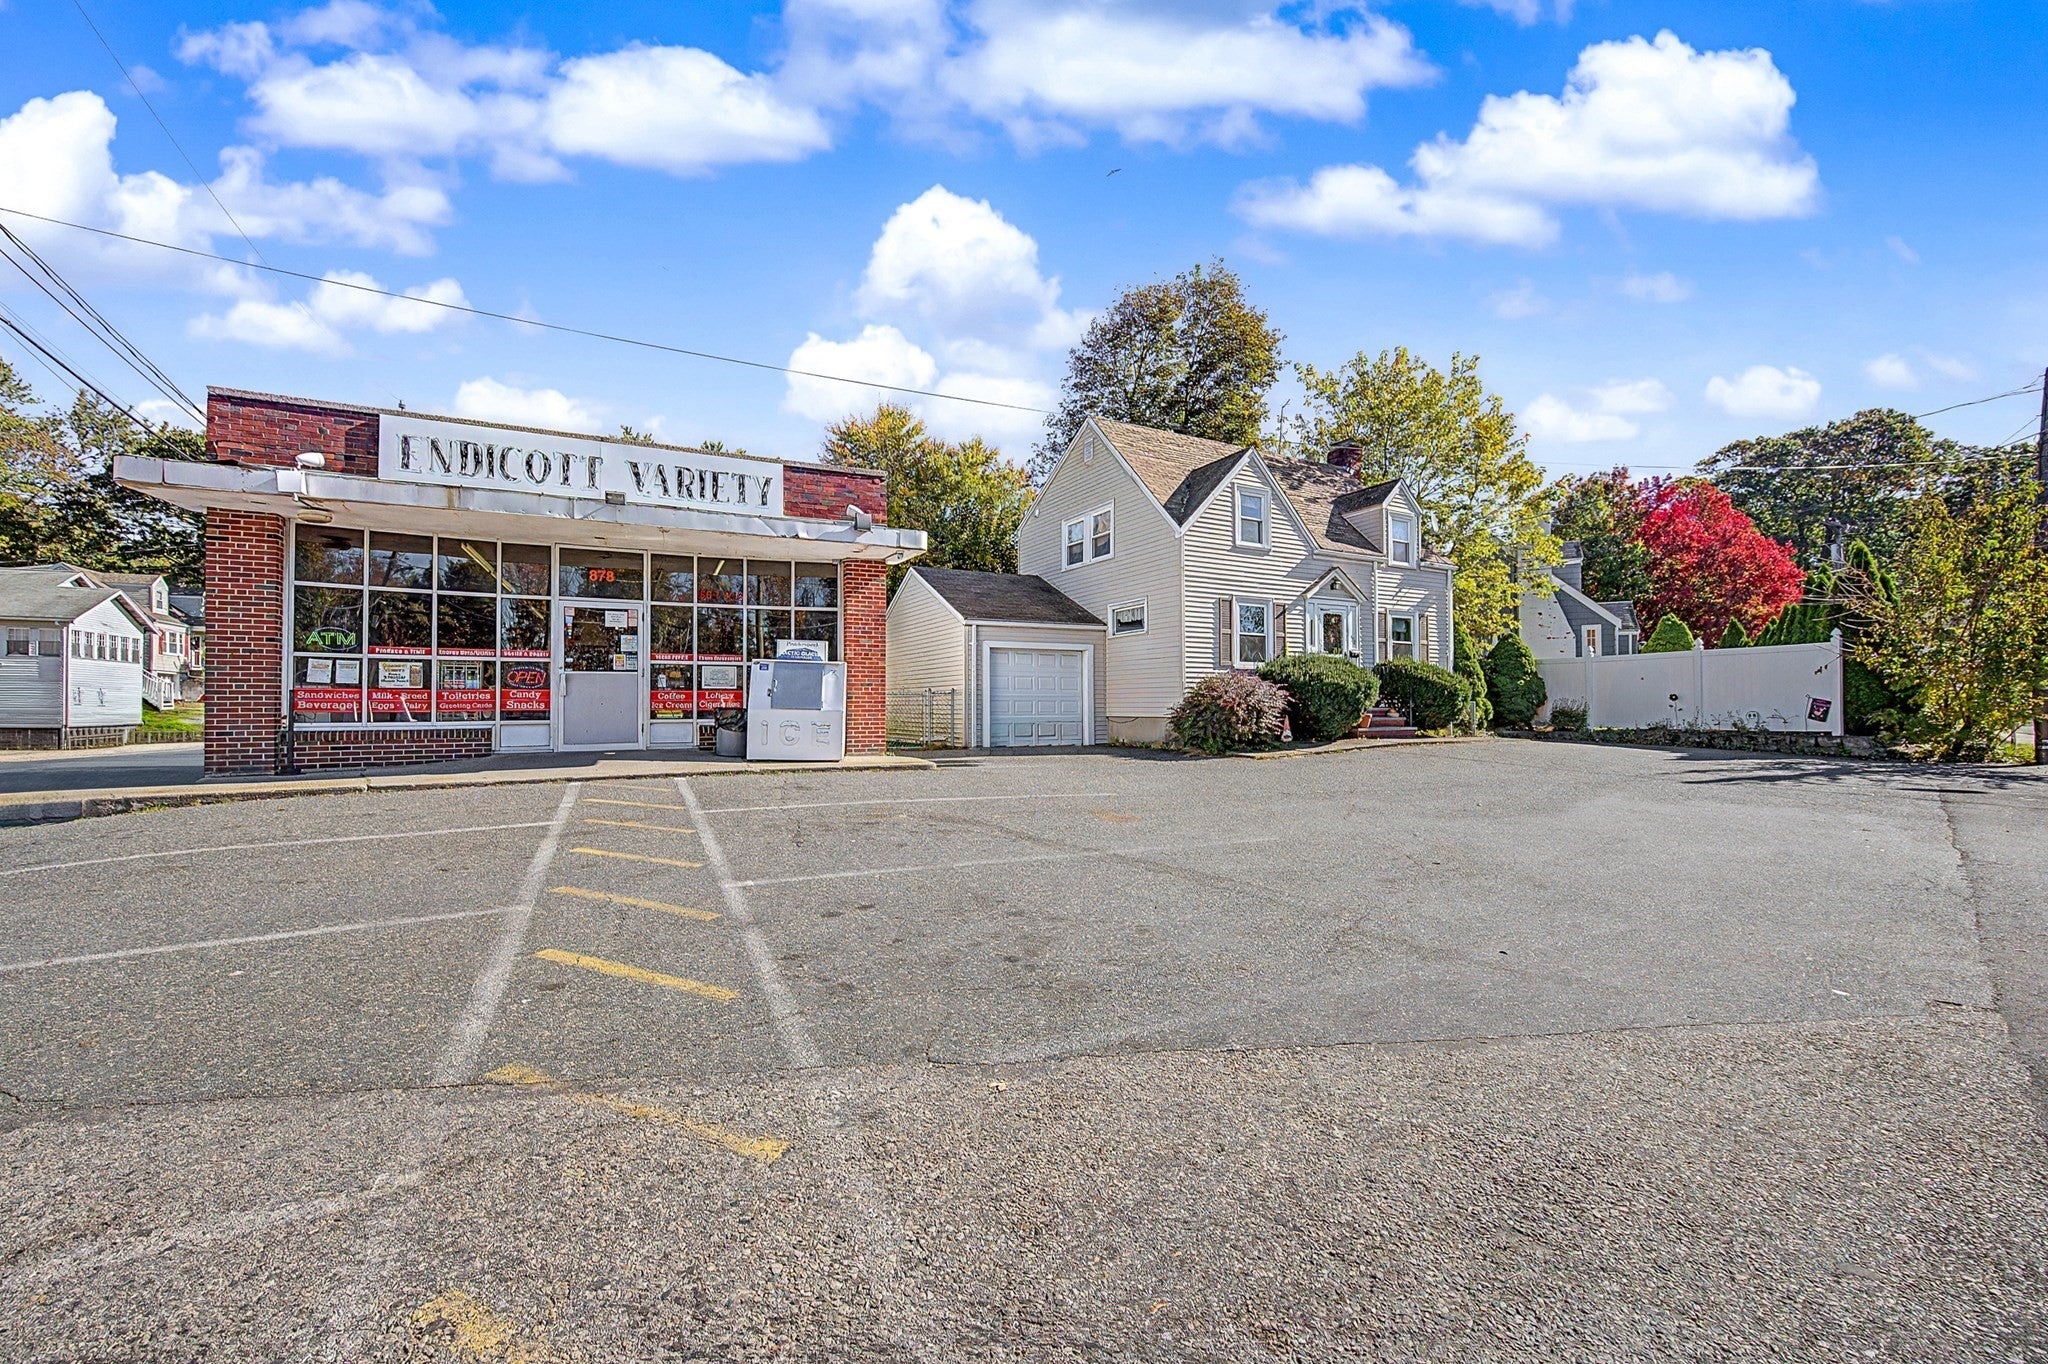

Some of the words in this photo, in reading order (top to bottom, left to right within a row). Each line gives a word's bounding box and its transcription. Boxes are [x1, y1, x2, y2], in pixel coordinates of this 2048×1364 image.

[397, 433, 603, 490] ENDICOTT
[625, 460, 773, 507] VARIETY
[589, 569, 615, 582] 878
[306, 631, 356, 645] ATM
[506, 670, 547, 684] OPEN
[297, 691, 360, 700] Sandwiches
[372, 692, 393, 700] Milk
[401, 692, 428, 700] Bread
[441, 692, 492, 701] Toiletries
[509, 690, 542, 700] Candy
[657, 692, 686, 700] Coffee
[297, 701, 360, 710] Beverages
[372, 702, 395, 710] Eggs
[439, 702, 471, 710] Greeting
[506, 700, 546, 709] Snacks
